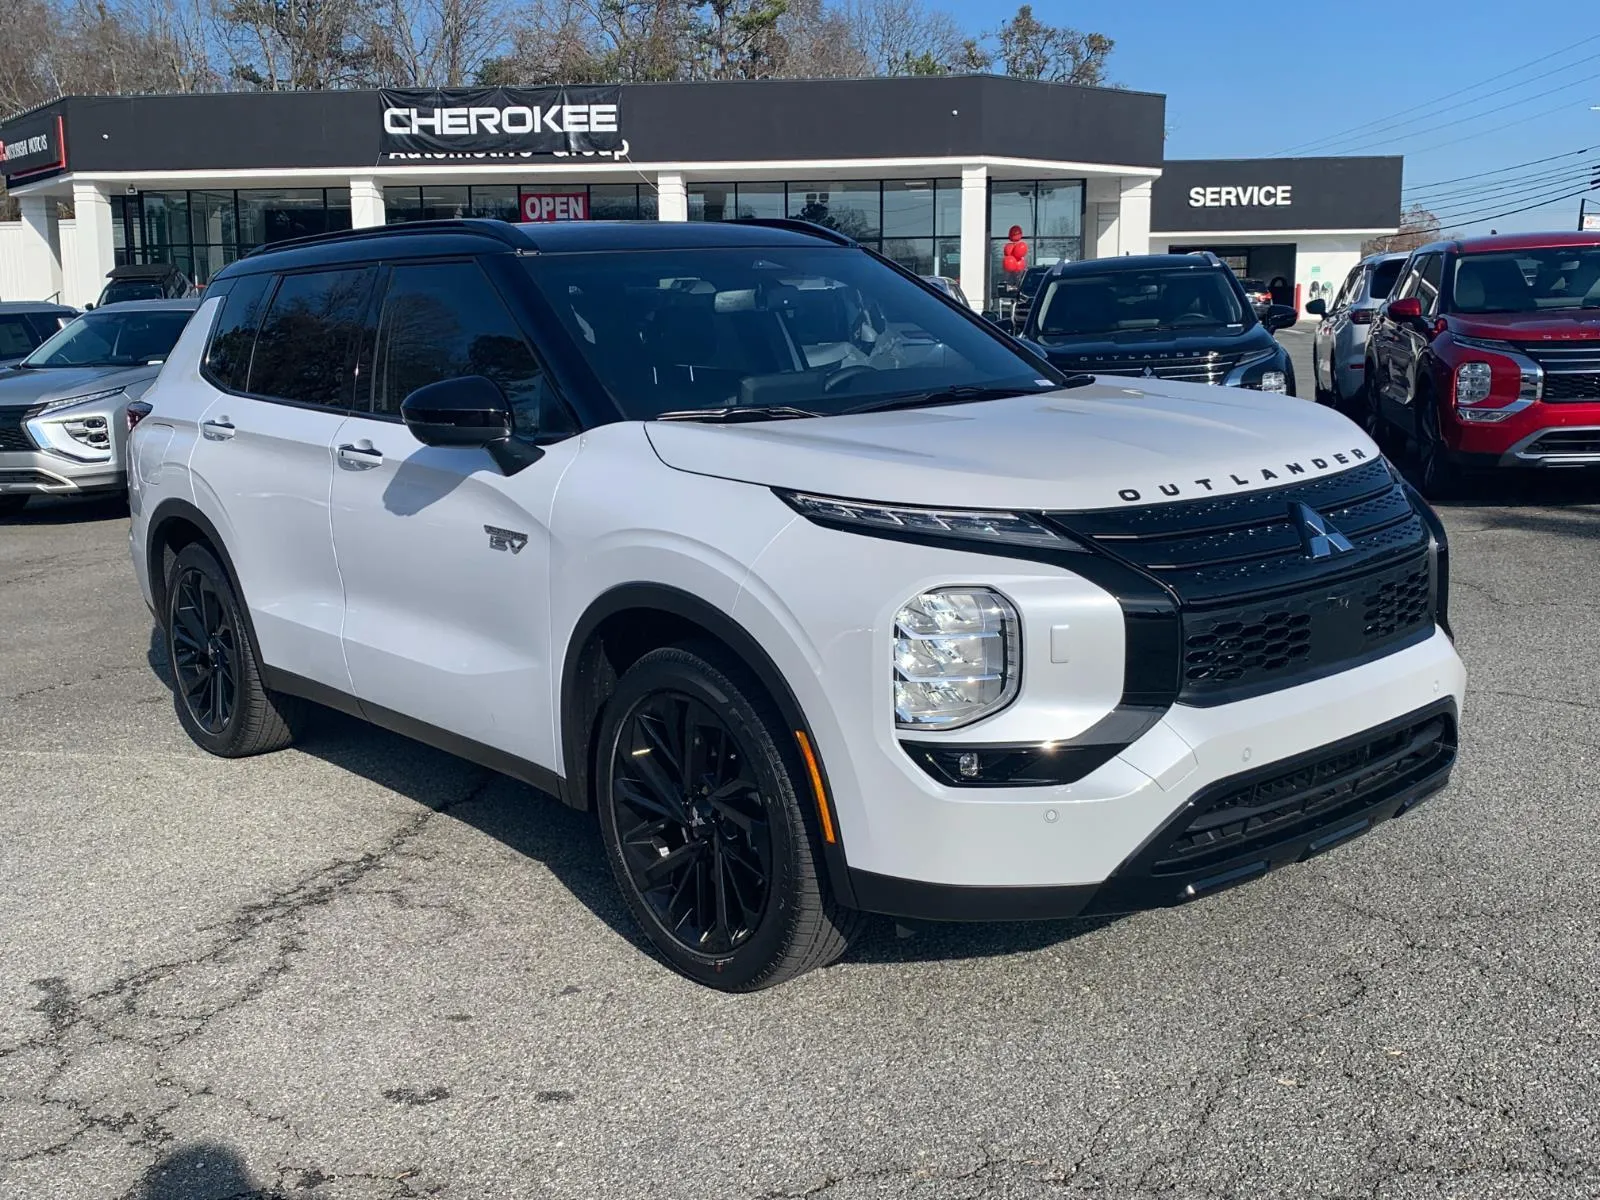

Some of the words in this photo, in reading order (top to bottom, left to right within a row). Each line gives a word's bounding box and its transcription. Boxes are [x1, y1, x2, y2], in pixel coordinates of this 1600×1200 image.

[383, 104, 618, 135] CHEROKEE
[524, 196, 584, 220] OPEN
[1188, 185, 1292, 207] SERVICE
[1117, 447, 1367, 502] OUTLANDER
